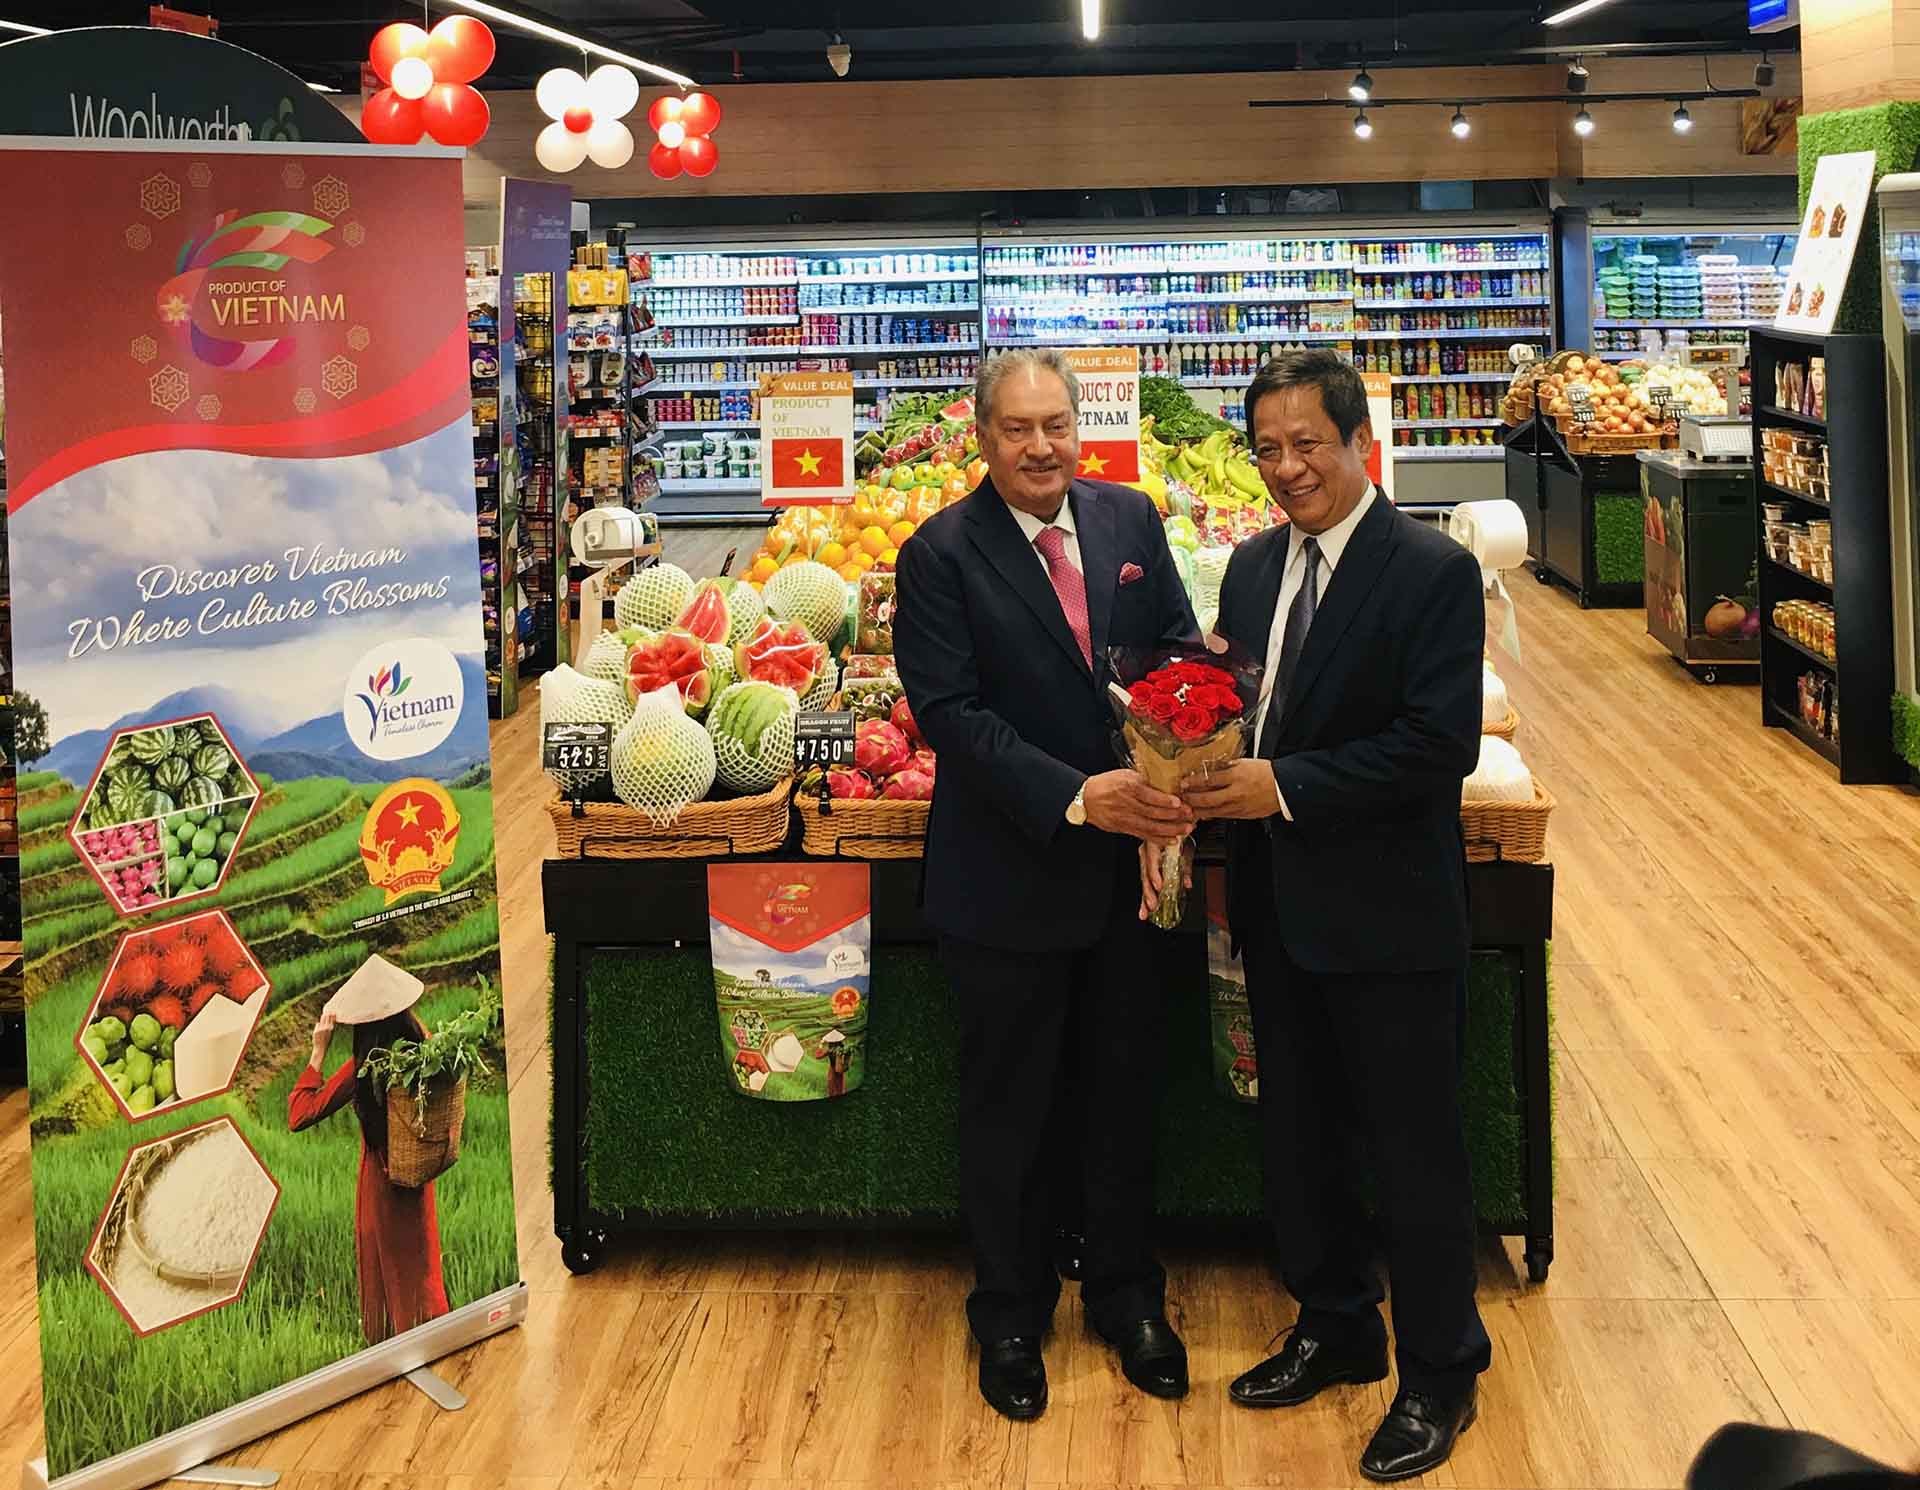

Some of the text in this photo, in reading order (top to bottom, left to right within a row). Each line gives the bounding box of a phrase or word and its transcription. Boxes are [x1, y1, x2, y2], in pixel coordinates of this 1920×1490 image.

[208, 279, 287, 295] PRODUCT OF
[210, 293, 346, 327] VIETNAM
[1105, 354, 1136, 366] DEAL
[783, 381, 849, 391] VALUE DEAL
[1078, 382, 1135, 402] DUCT OF
[772, 399, 832, 409] PRODUCT
[772, 413, 788, 424] OF
[1078, 410, 1129, 426] TNAM
[772, 427, 831, 437] VIETNAM
[136, 541, 407, 602] Discover Vietnam
[68, 575, 450, 659] Where Culture Blossoms
[354, 693, 455, 744] Vietnam
